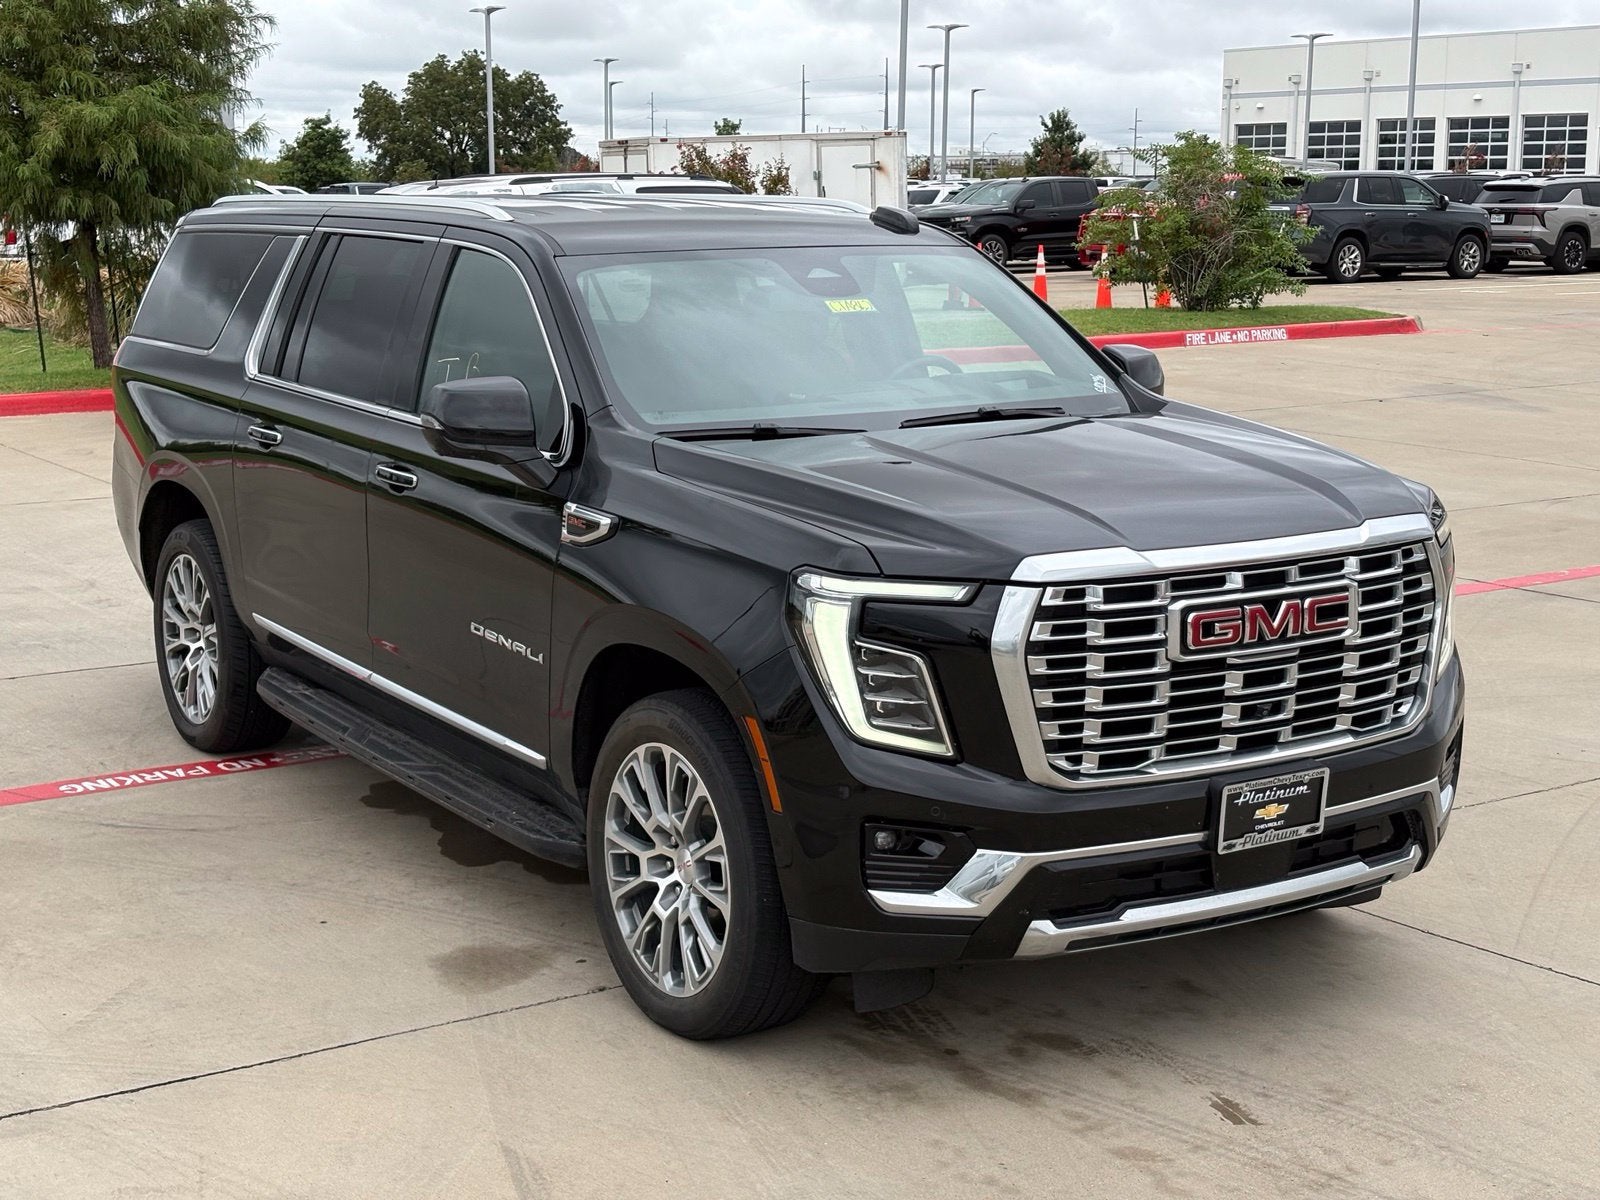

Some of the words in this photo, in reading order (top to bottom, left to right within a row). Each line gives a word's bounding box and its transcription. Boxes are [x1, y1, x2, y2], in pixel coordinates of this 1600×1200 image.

[1186, 333, 1206, 345] FIRE
[1208, 331, 1232, 344] LANE
[1237, 330, 1250, 342] NO
[1251, 328, 1287, 341] PARKING
[1187, 593, 1349, 650] GMC
[470, 621, 544, 665] DENALI
[216, 758, 268, 772] NO
[58, 765, 211, 794] PARKING
[1227, 770, 1326, 793] wwwPlatinumChevyTexas.com
[1233, 785, 1311, 806] Platinum
[1255, 820, 1286, 831] CHEVROLET
[1239, 828, 1303, 848] Platinum
